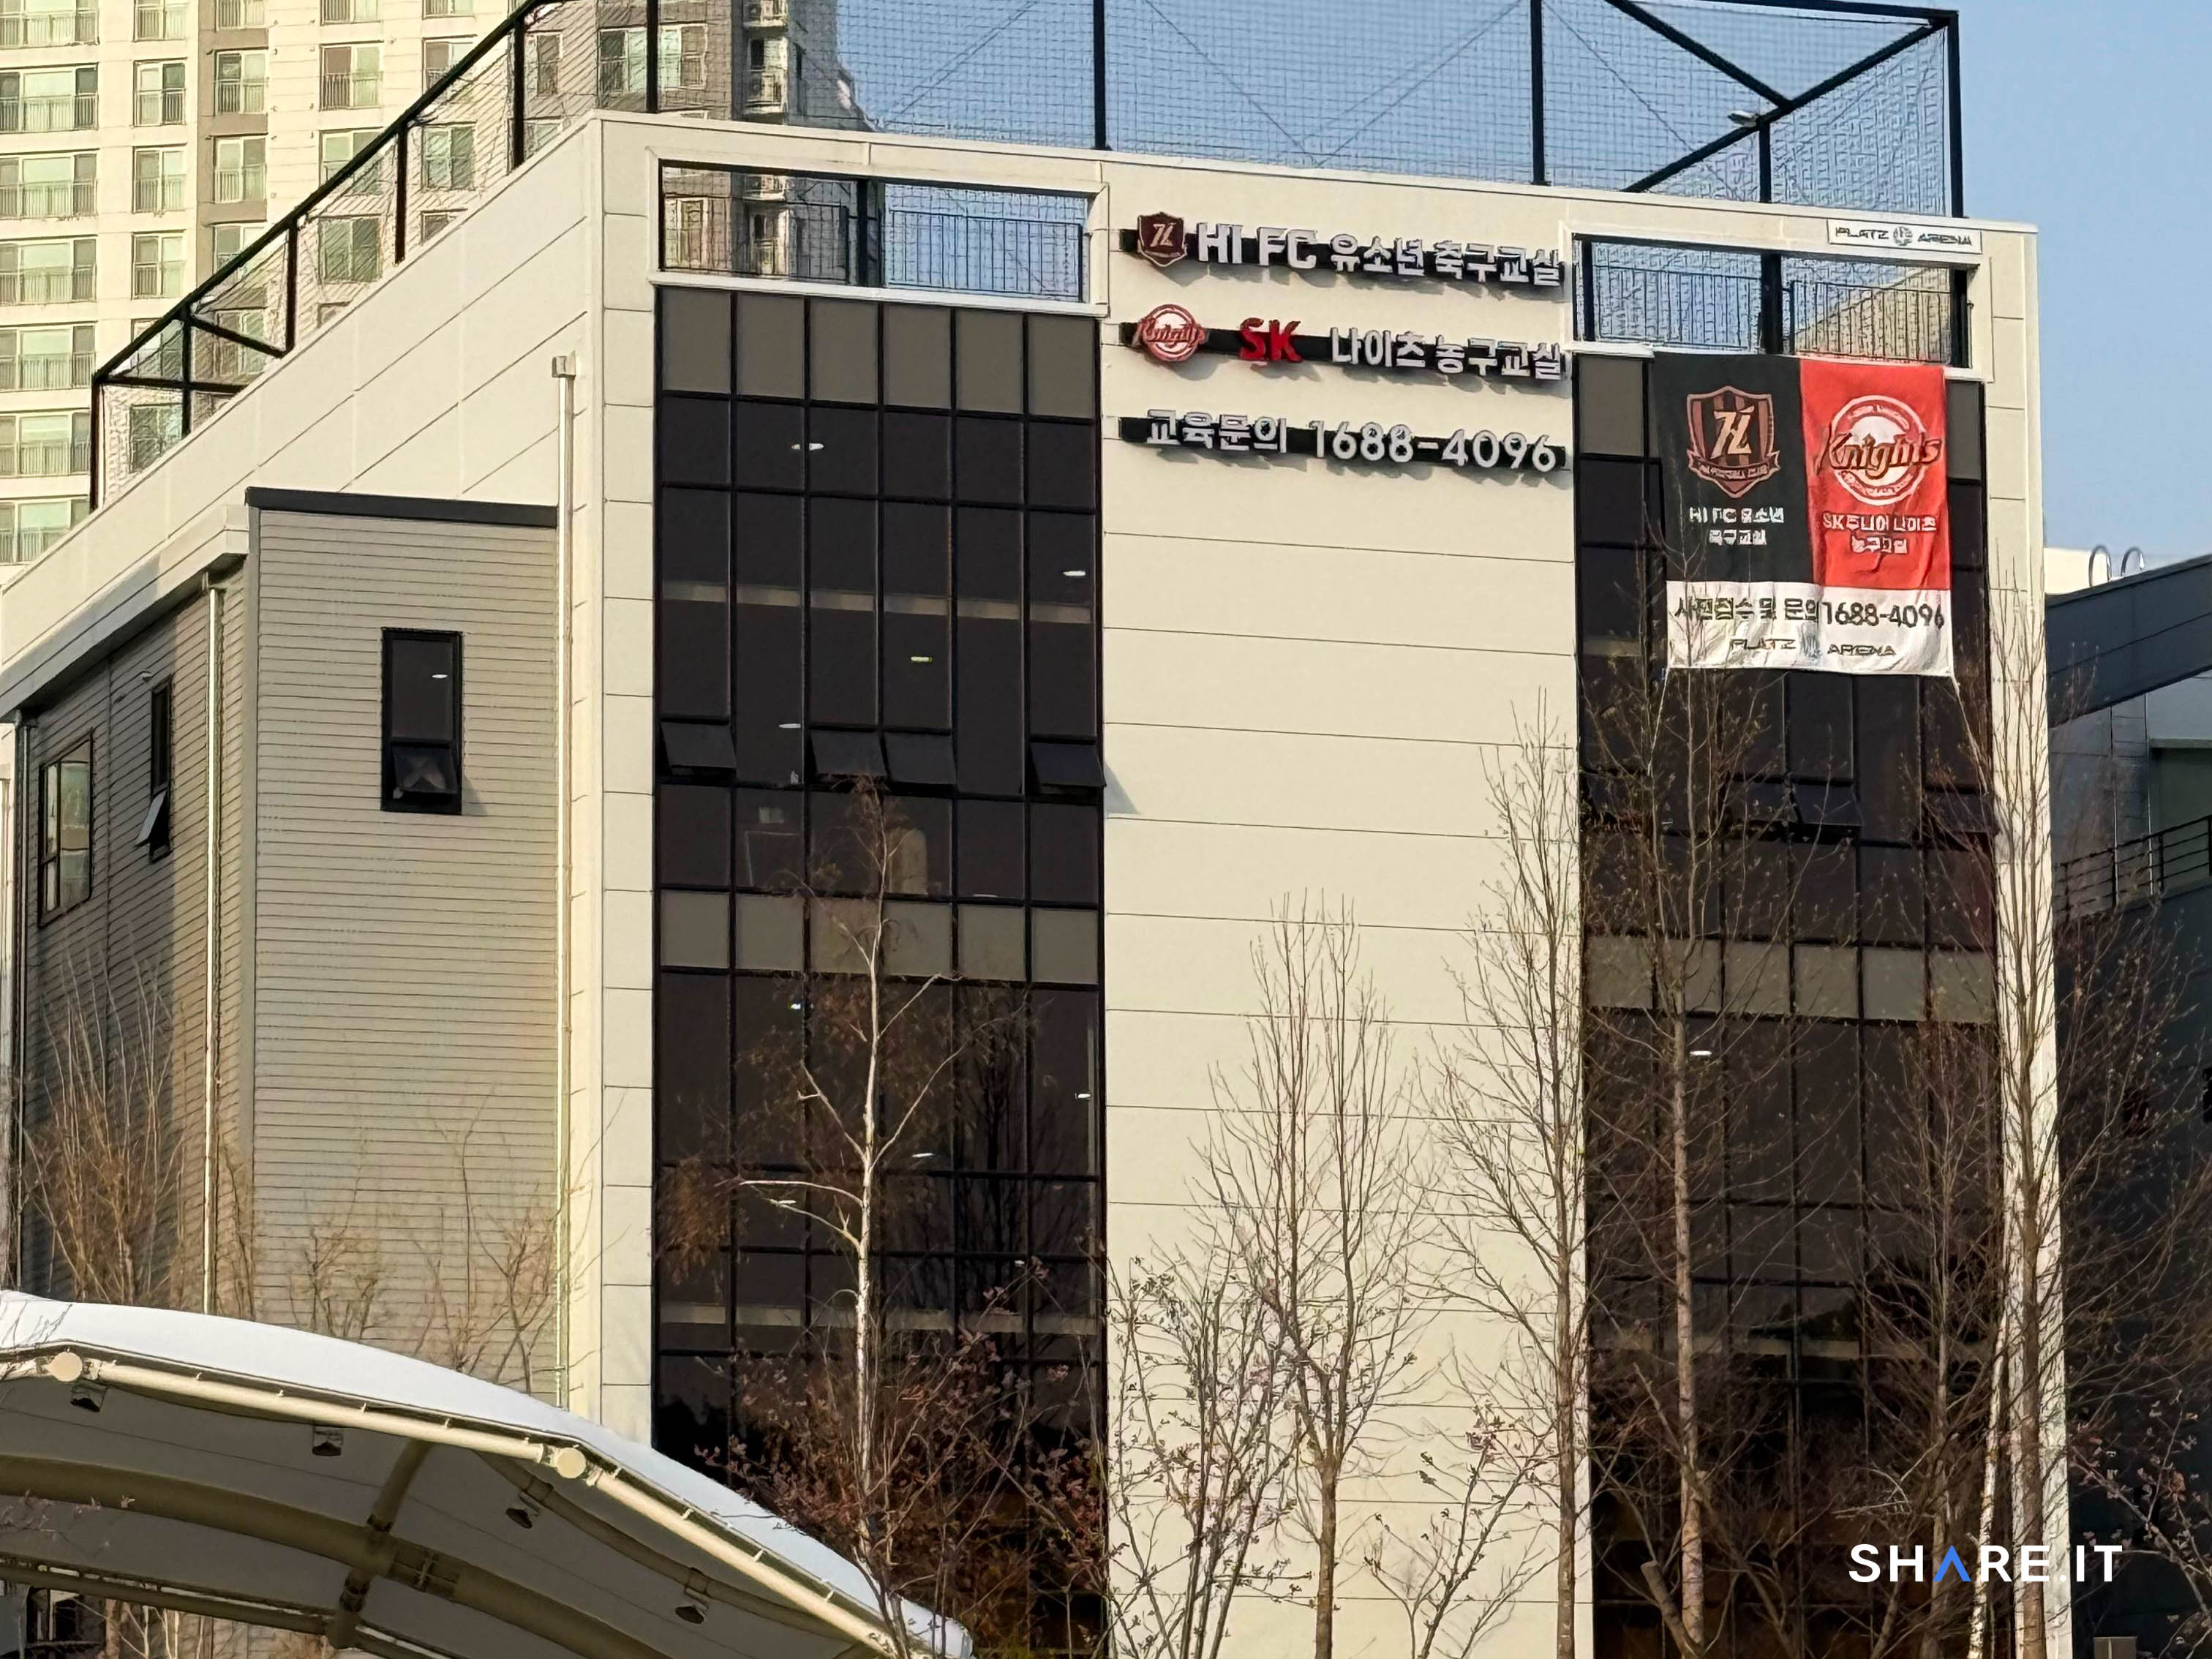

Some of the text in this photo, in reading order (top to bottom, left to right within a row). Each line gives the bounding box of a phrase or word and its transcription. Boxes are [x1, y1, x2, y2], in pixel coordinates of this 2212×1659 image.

[1197, 222, 1243, 264] HI
[1257, 226, 1317, 269] FC
[1331, 233, 1426, 276] 유소년
[1434, 240, 1560, 286] 축구교실
[1238, 317, 1561, 380] SK 나이츠 농구교실
[1147, 409, 1557, 473] 교육문의 1688-4096
[1821, 601, 1944, 629] 1688-4096
